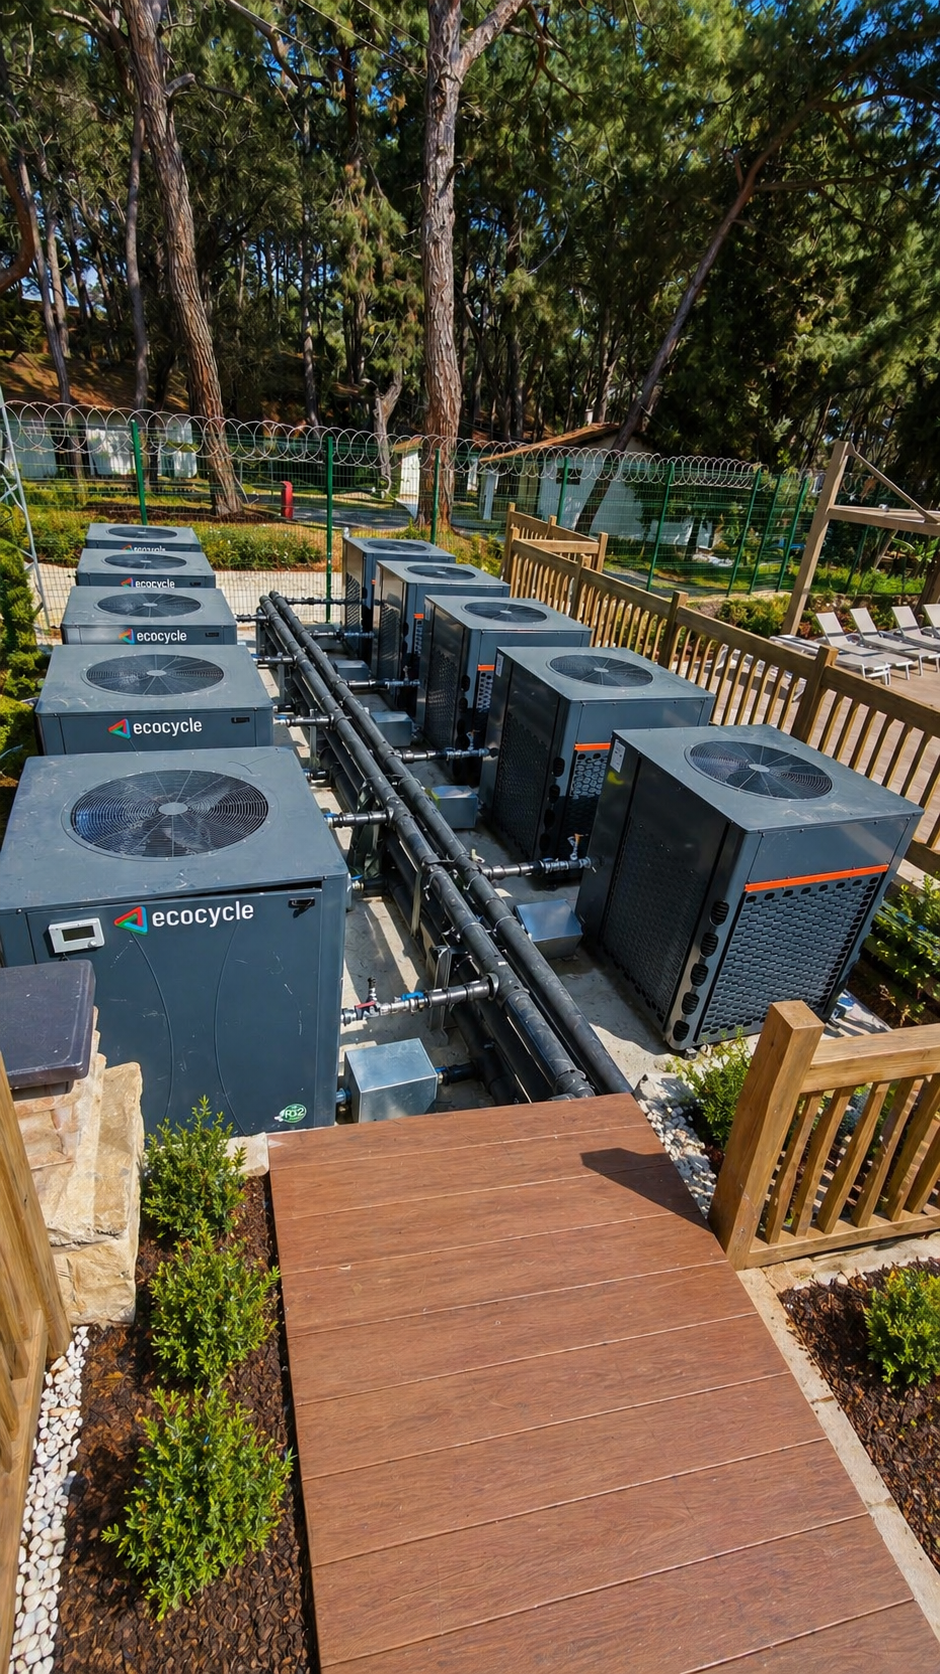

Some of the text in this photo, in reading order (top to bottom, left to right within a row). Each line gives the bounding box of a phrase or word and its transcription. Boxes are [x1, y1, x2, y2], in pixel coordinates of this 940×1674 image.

[135, 578, 175, 588] ecocycle
[136, 629, 187, 644] ecocycle
[133, 717, 203, 737] ecocycle
[152, 900, 254, 928] ecocycle
